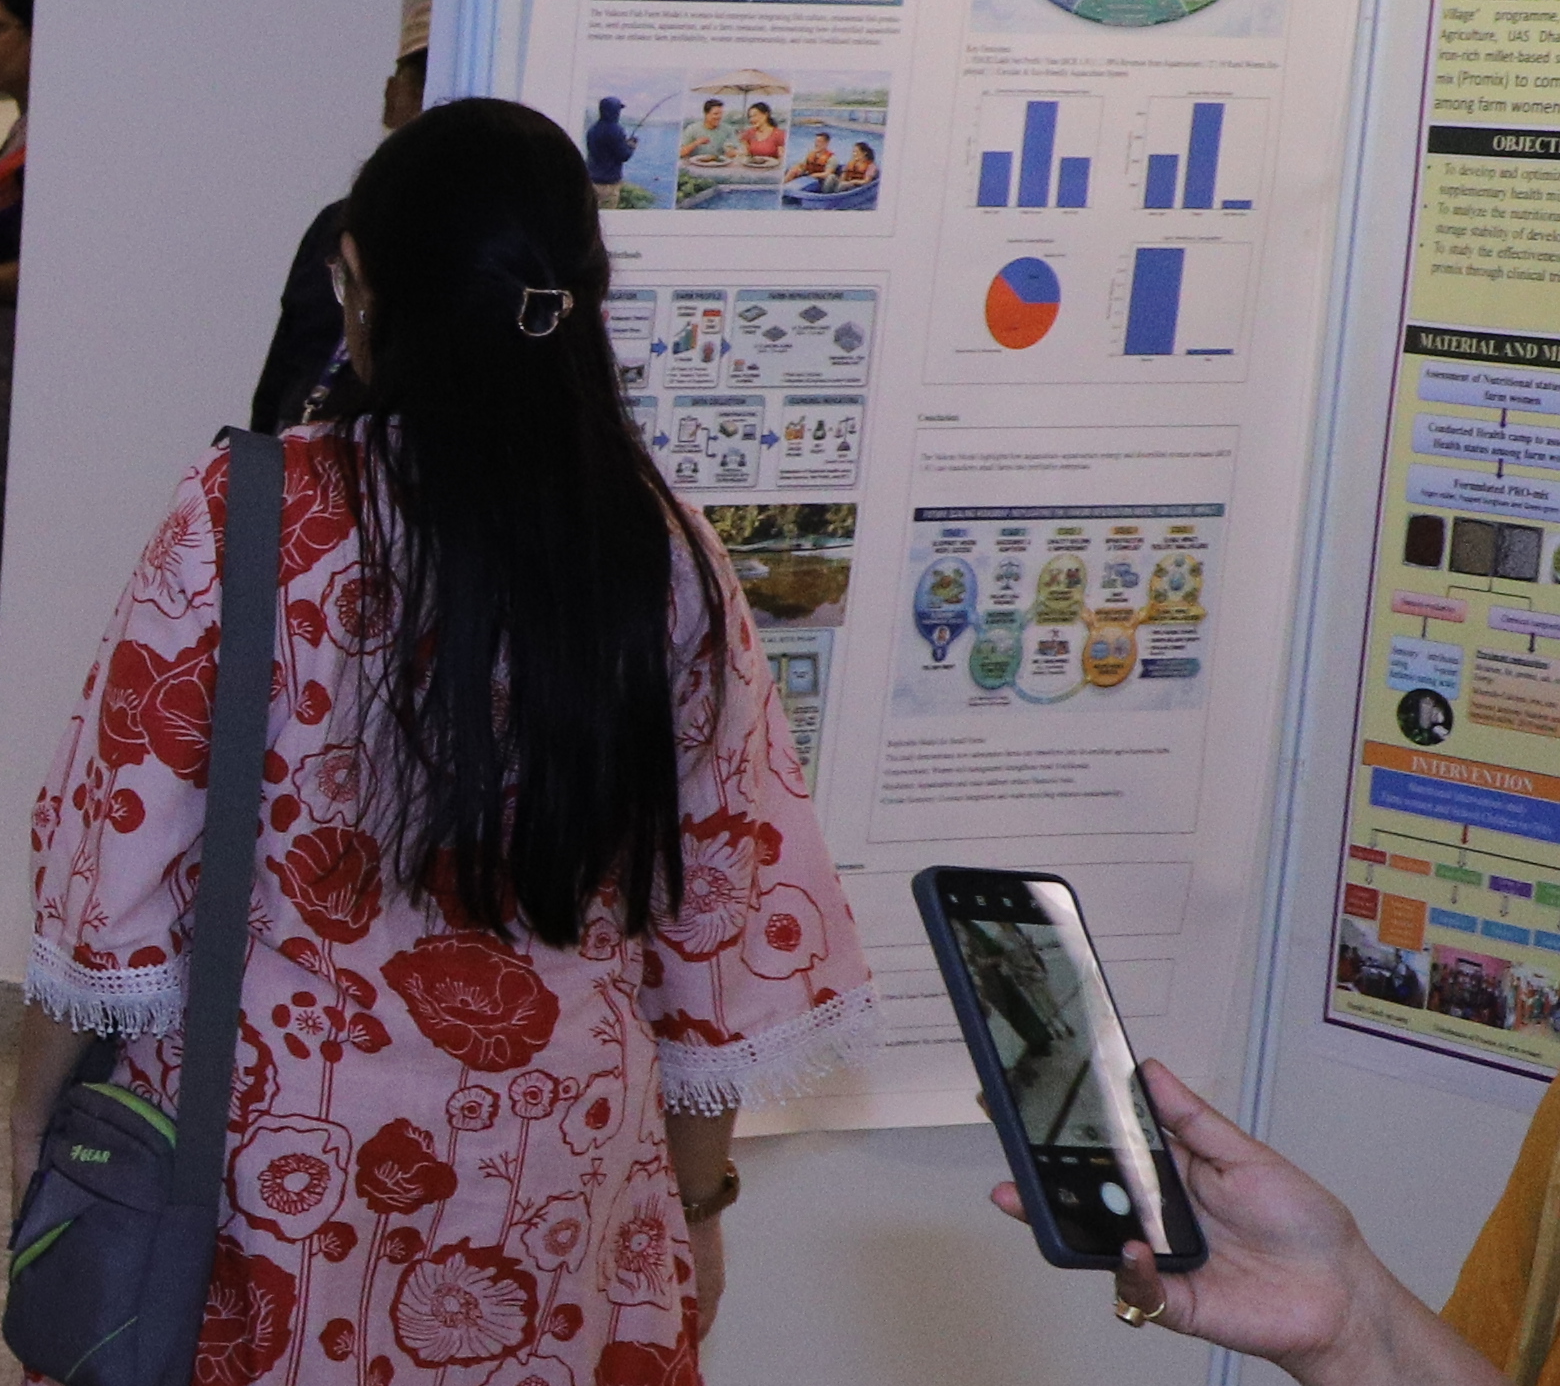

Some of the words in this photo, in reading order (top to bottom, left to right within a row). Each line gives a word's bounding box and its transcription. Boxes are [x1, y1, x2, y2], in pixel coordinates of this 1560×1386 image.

[1421, 333, 1499, 358] MATERIAL
[1504, 339, 1538, 359] AND
[1410, 756, 1534, 792] INTERVENTION
